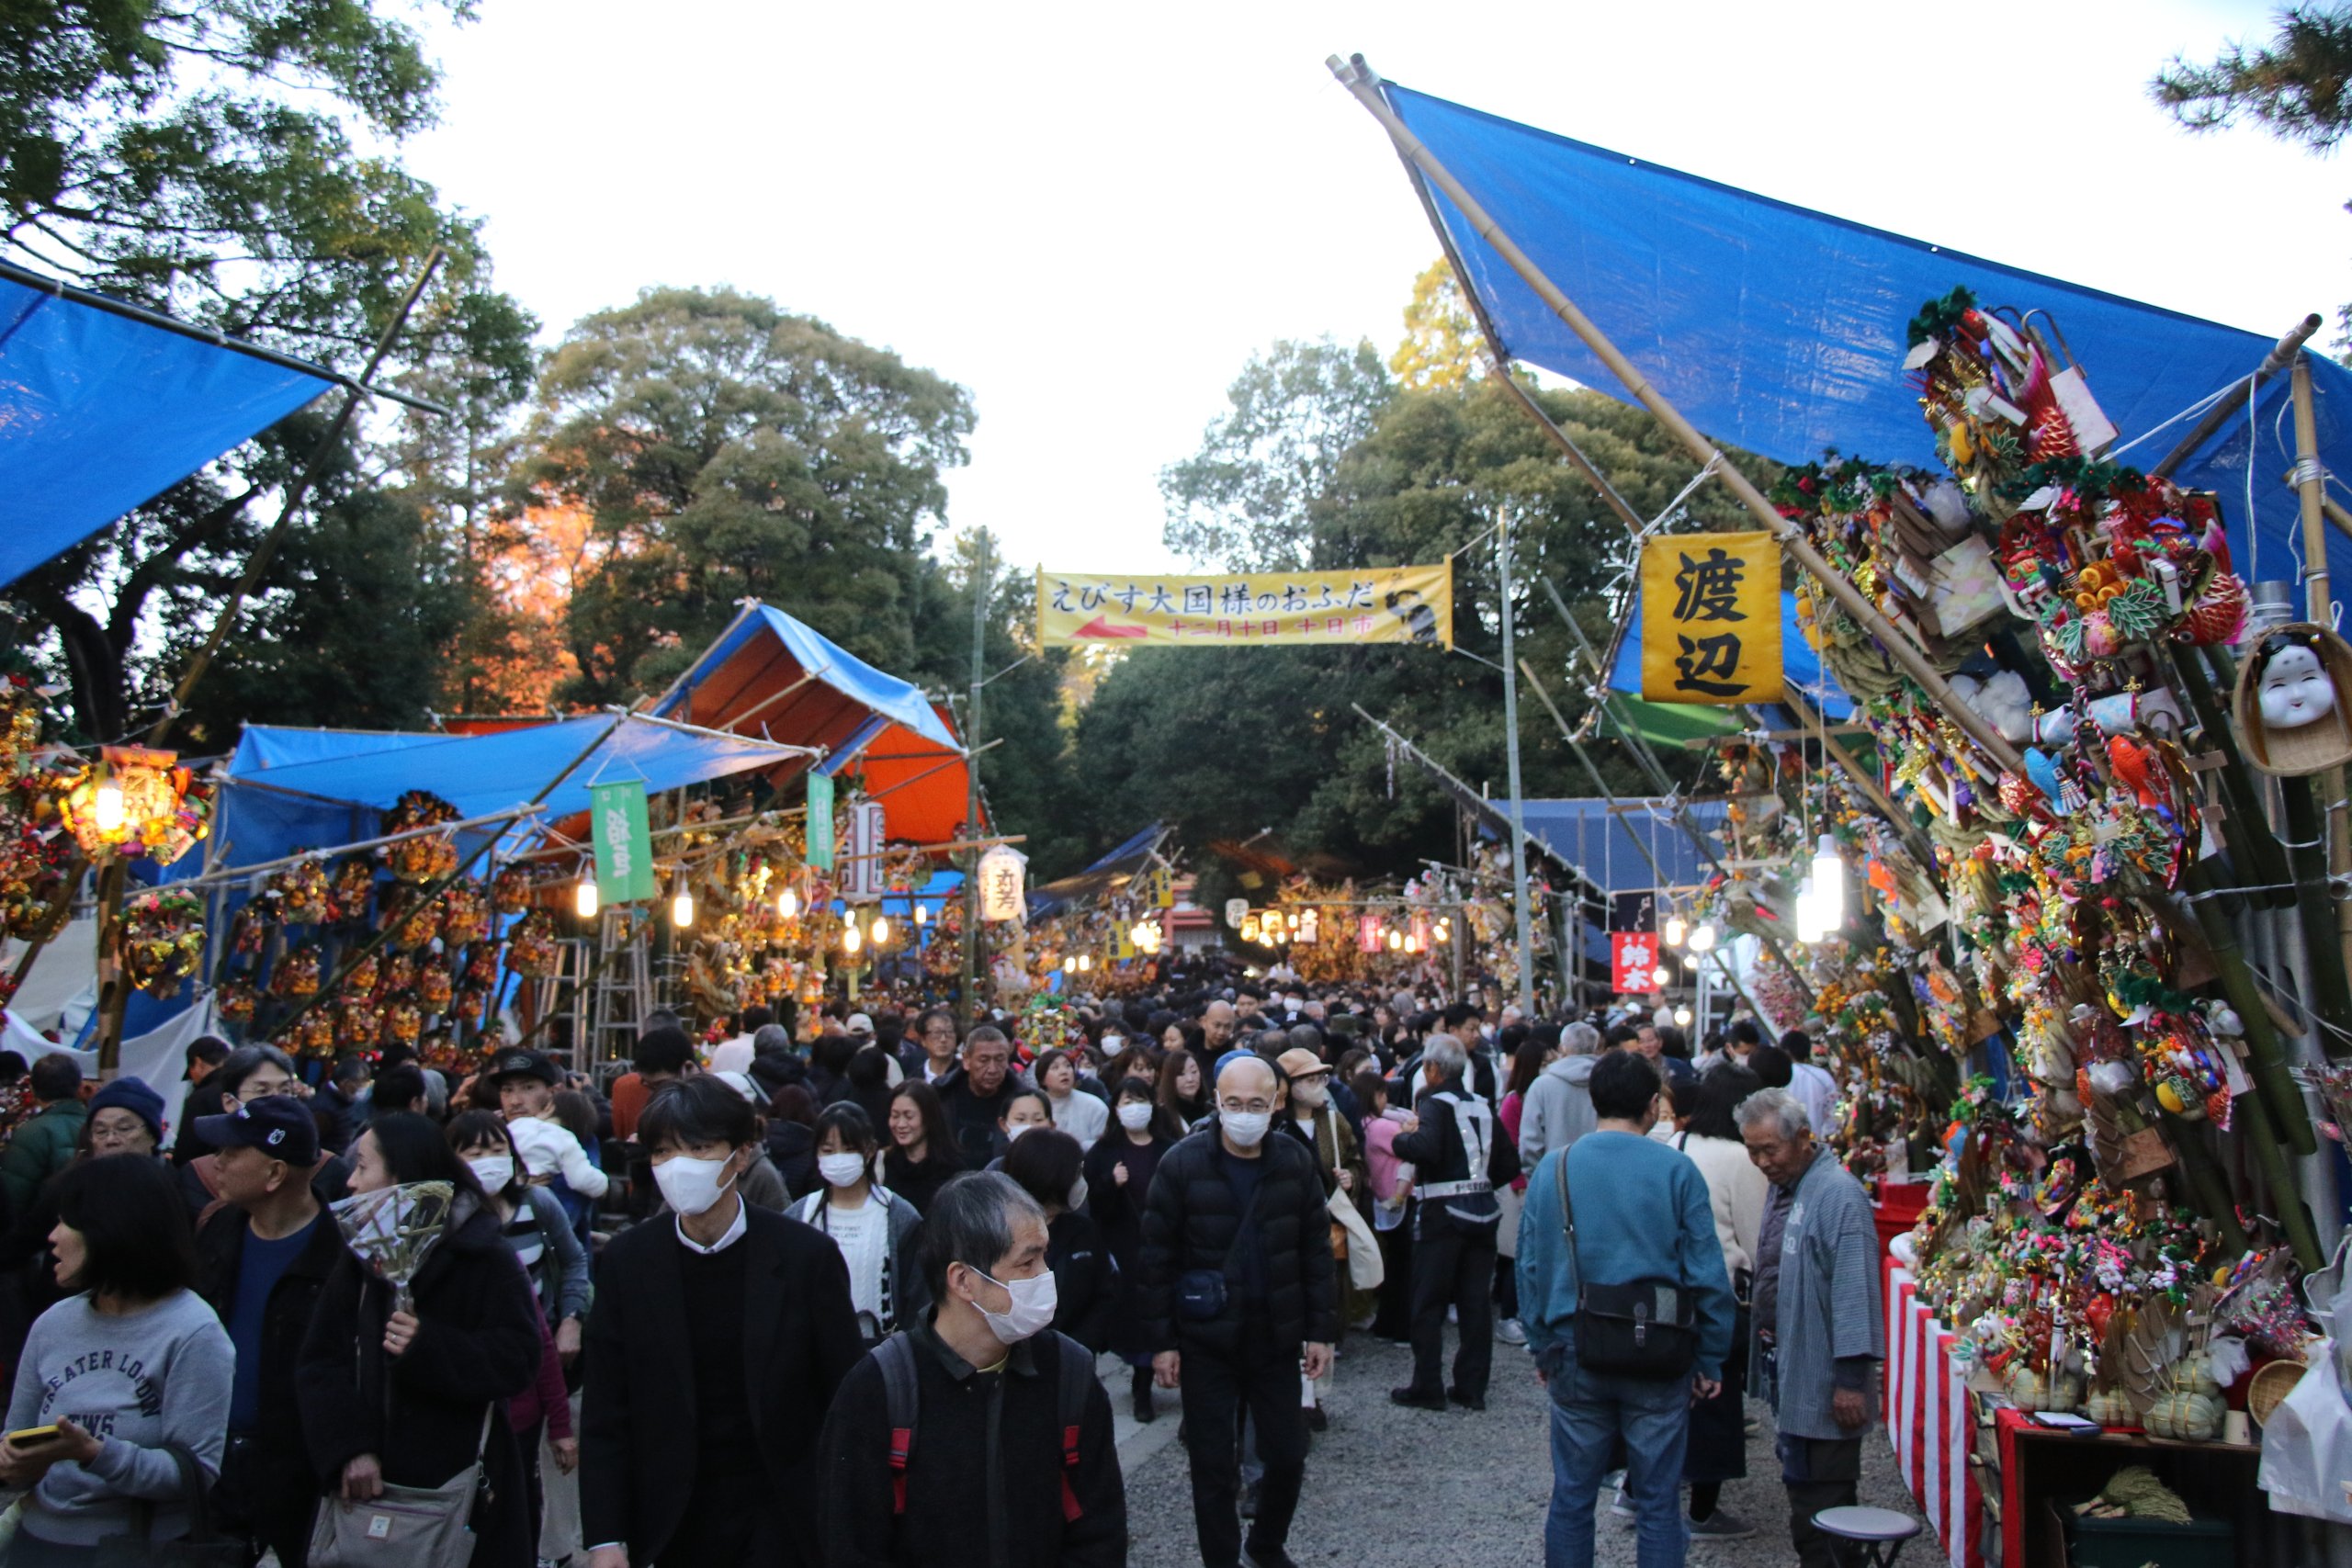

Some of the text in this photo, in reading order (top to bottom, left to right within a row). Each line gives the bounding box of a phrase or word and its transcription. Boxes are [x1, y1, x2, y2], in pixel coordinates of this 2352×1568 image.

[1052, 581, 1375, 615] えびす大国様のおふだ
[1167, 615, 1375, 637] 十二月十日 十日市
[1673, 547, 1752, 697] 渡辺
[1620, 942, 1651, 991] 鈴木
